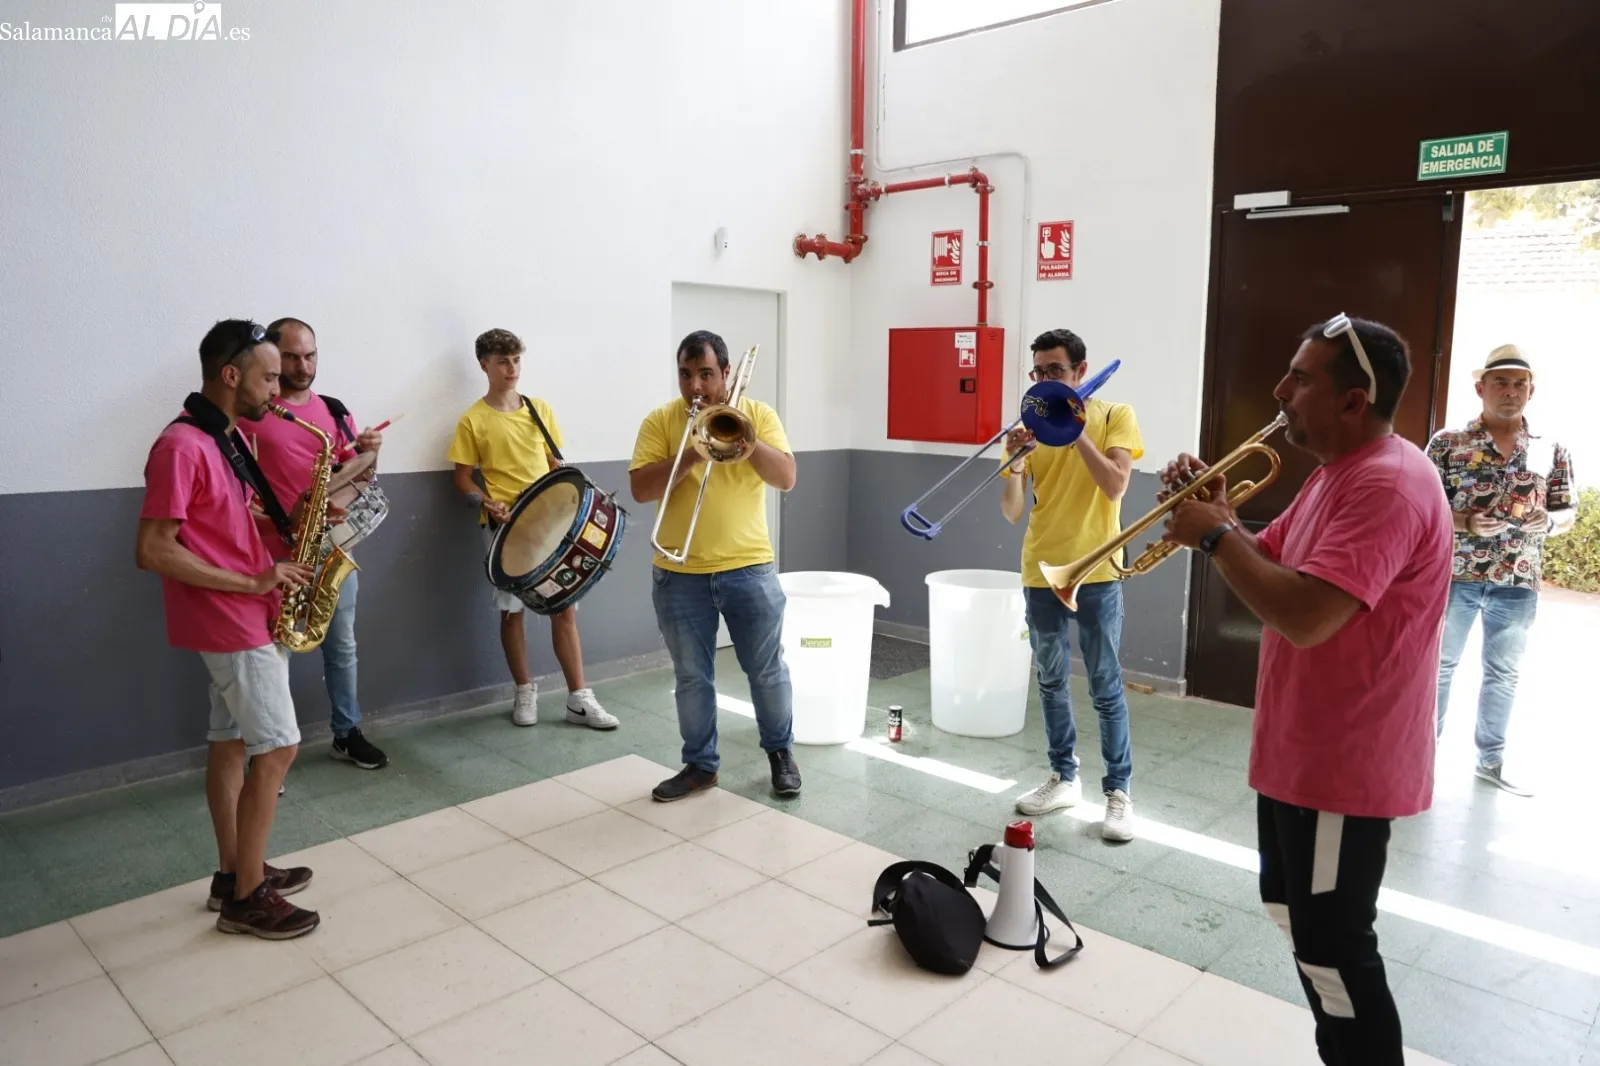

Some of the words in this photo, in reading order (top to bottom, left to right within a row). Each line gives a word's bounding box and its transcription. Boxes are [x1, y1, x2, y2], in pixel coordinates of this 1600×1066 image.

[1431, 142, 1474, 158] SALIDA
[1477, 139, 1495, 153] DE
[1422, 154, 1501, 174] EMERGENCIA
[801, 638, 830, 648] Denox
